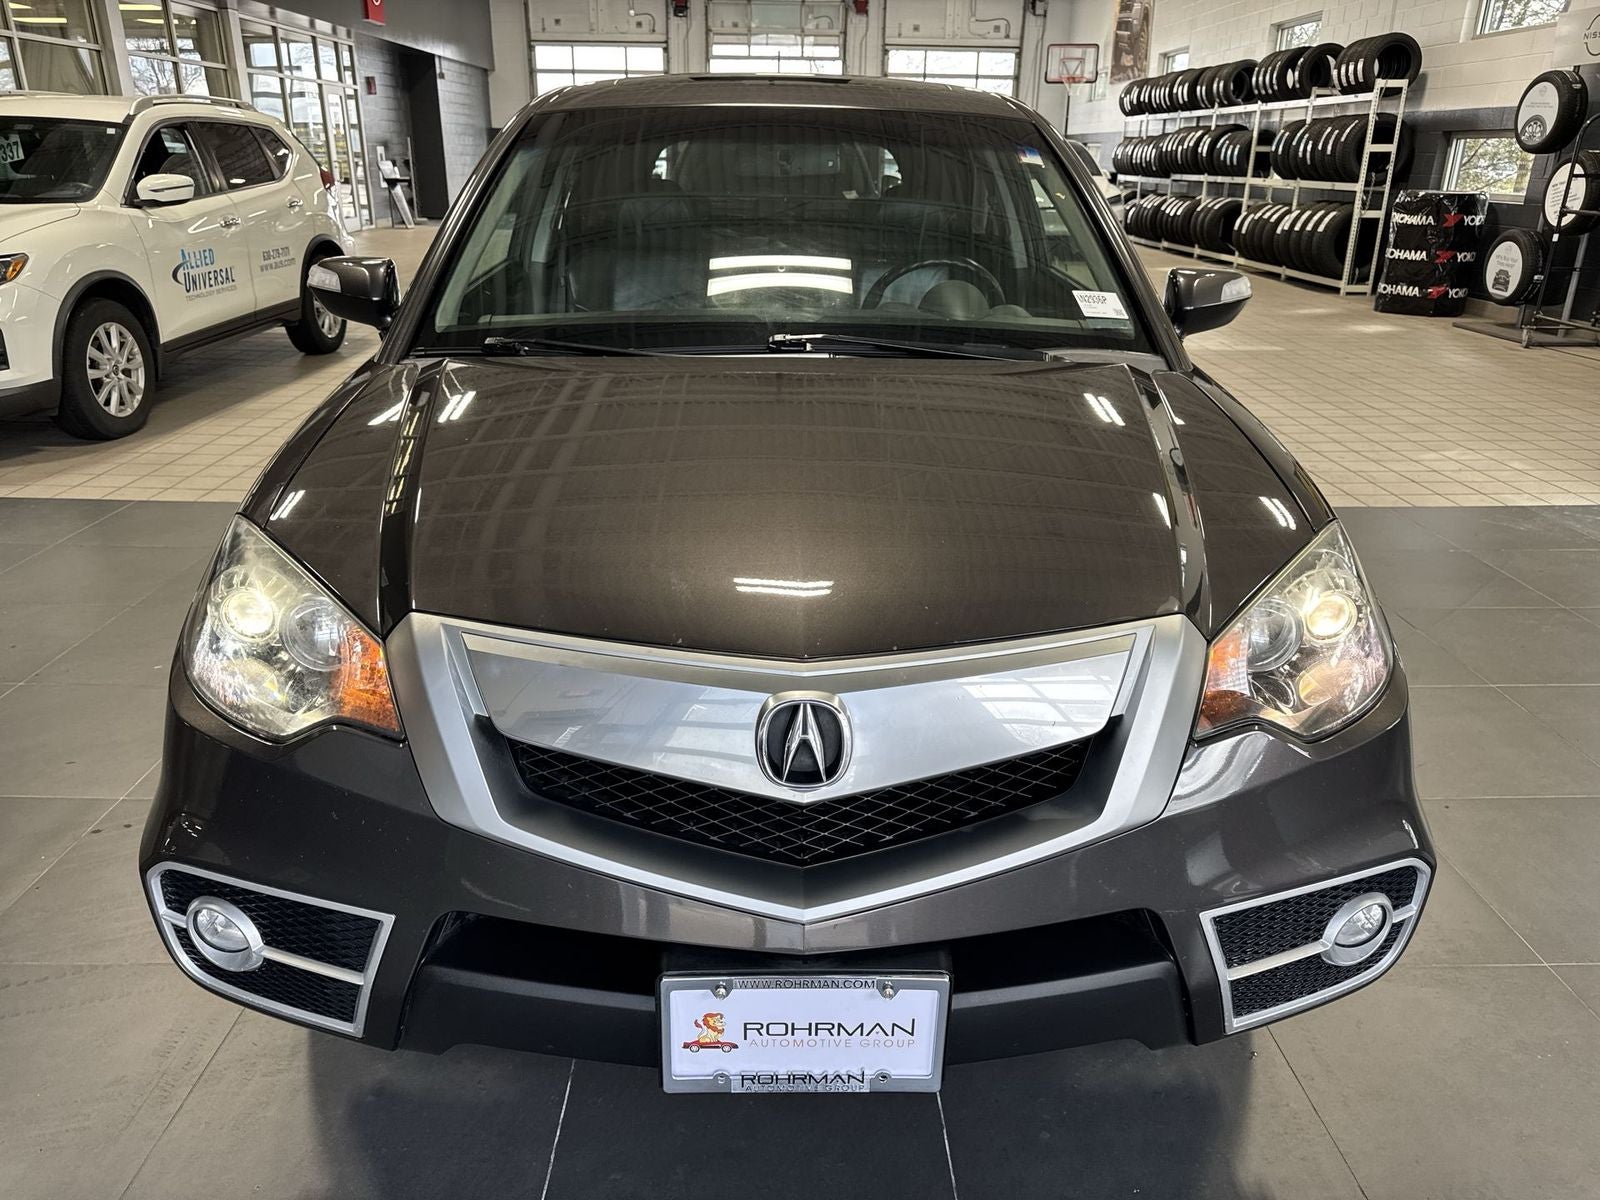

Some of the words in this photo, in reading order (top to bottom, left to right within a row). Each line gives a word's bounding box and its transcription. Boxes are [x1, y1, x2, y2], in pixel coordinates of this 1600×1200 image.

[181, 248, 215, 270] ALLIED
[184, 267, 235, 293] UNIVERSAL
[738, 979, 876, 989] WWW.ROHRMAN.COM
[743, 1018, 916, 1040] ROHRMAN
[750, 1039, 852, 1048] AUTOMOTIVE
[860, 1039, 915, 1048] GROUP
[741, 1071, 865, 1087] ROHRMAN
[746, 1084, 818, 1092] AUTOMOTIVE
[825, 1084, 865, 1092] GROUP
